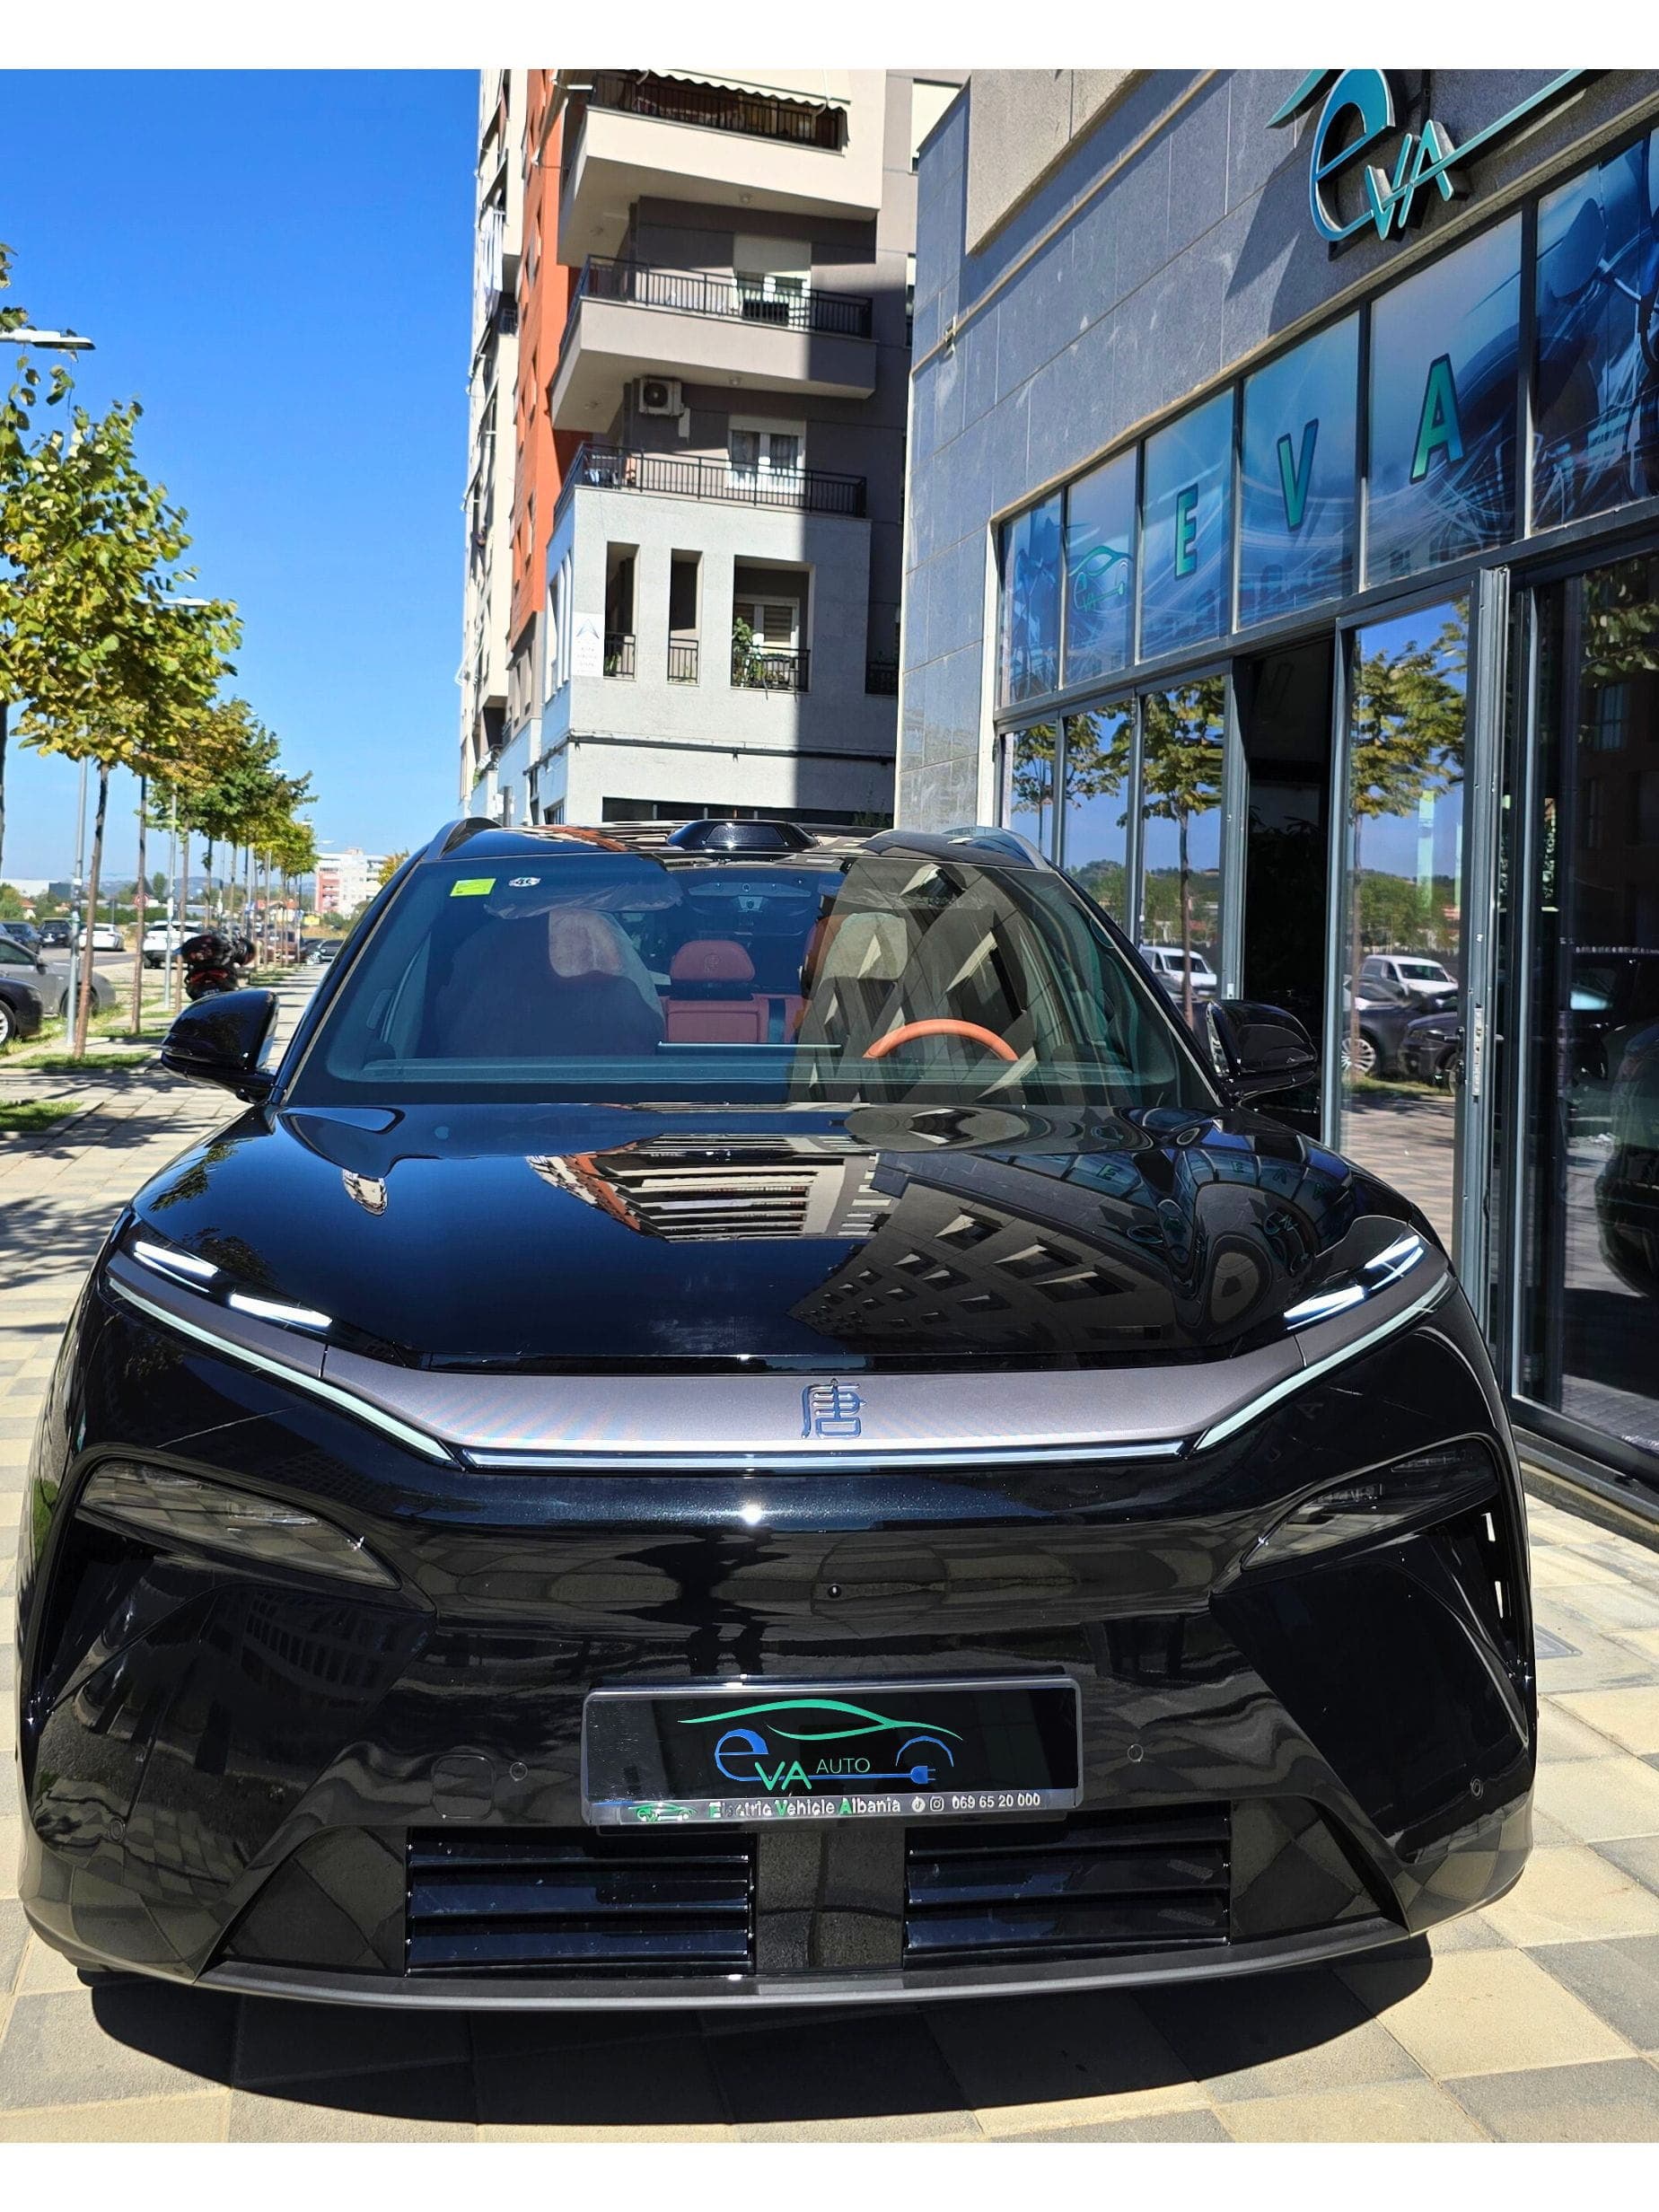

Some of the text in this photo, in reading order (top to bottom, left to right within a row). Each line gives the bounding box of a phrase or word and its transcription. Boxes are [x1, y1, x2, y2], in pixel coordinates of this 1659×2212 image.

[802, 1378, 867, 1439] 唐
[816, 1757, 872, 1775] AUTO
[775, 1798, 836, 1817] Vehicle
[838, 1796, 901, 1815] Albania
[952, 1795, 976, 1810] 069
[979, 1795, 995, 1808] 65
[997, 1794, 1014, 1807] 20
[1017, 1792, 1040, 1806] 000
